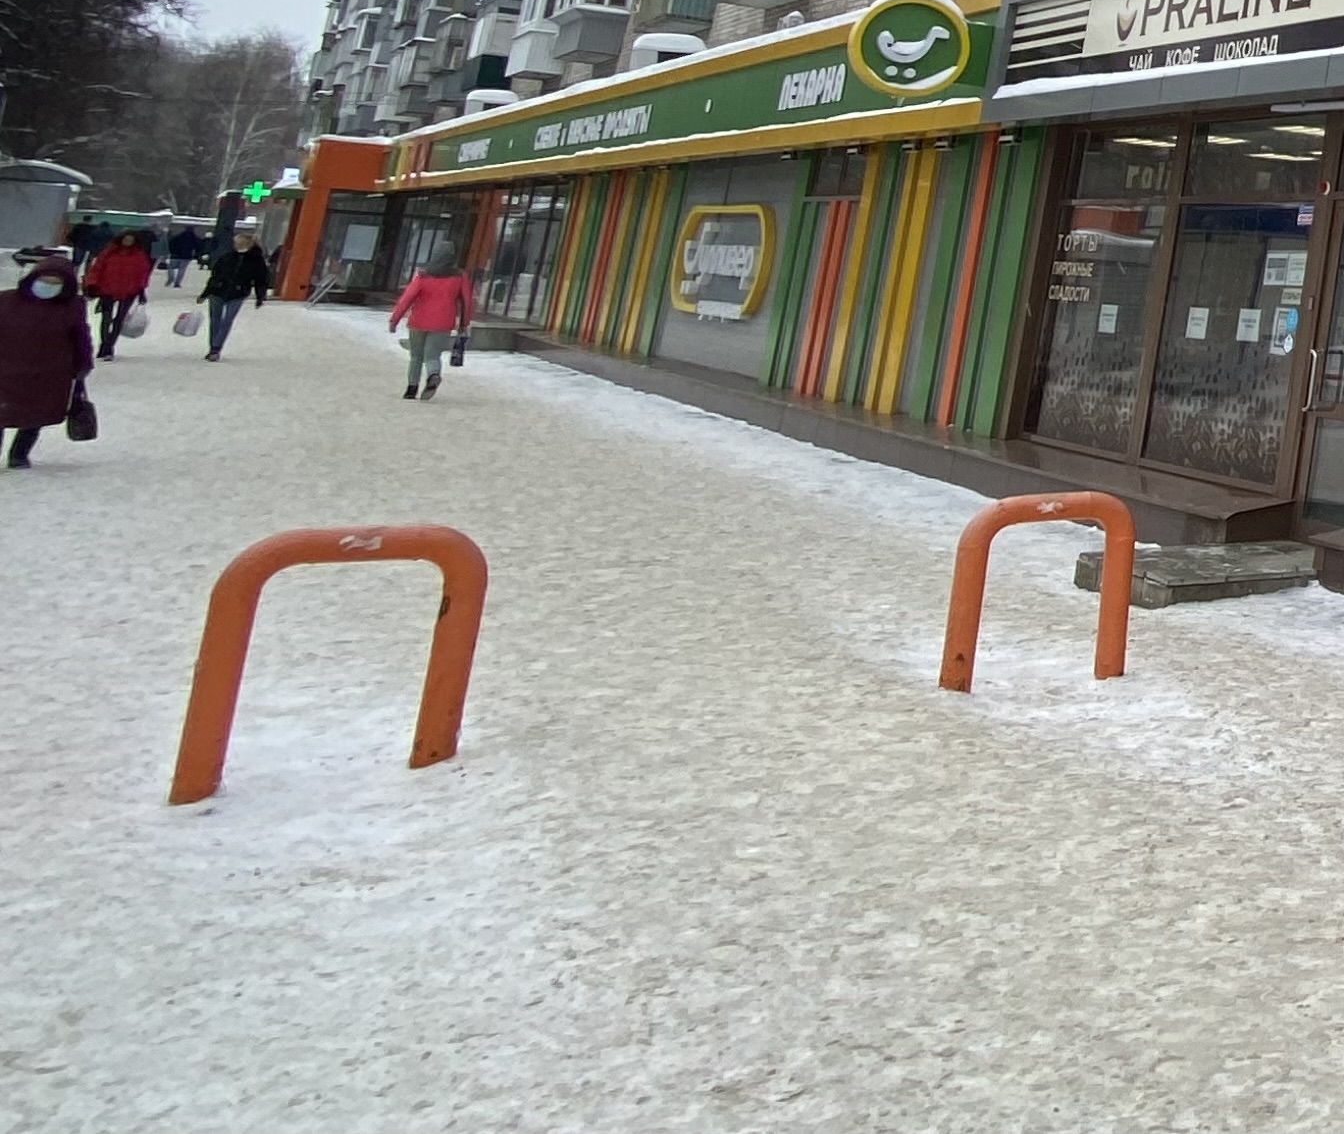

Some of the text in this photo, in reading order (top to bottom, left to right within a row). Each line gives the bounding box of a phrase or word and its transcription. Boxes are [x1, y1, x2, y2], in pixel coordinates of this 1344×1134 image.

[1129, 33, 1279, 72] ЧАЙ КОФЕ ШОКОЛАД
[1057, 233, 1099, 253] ТОРТЫ
[1048, 284, 1090, 304] СЛАДОСТИ
